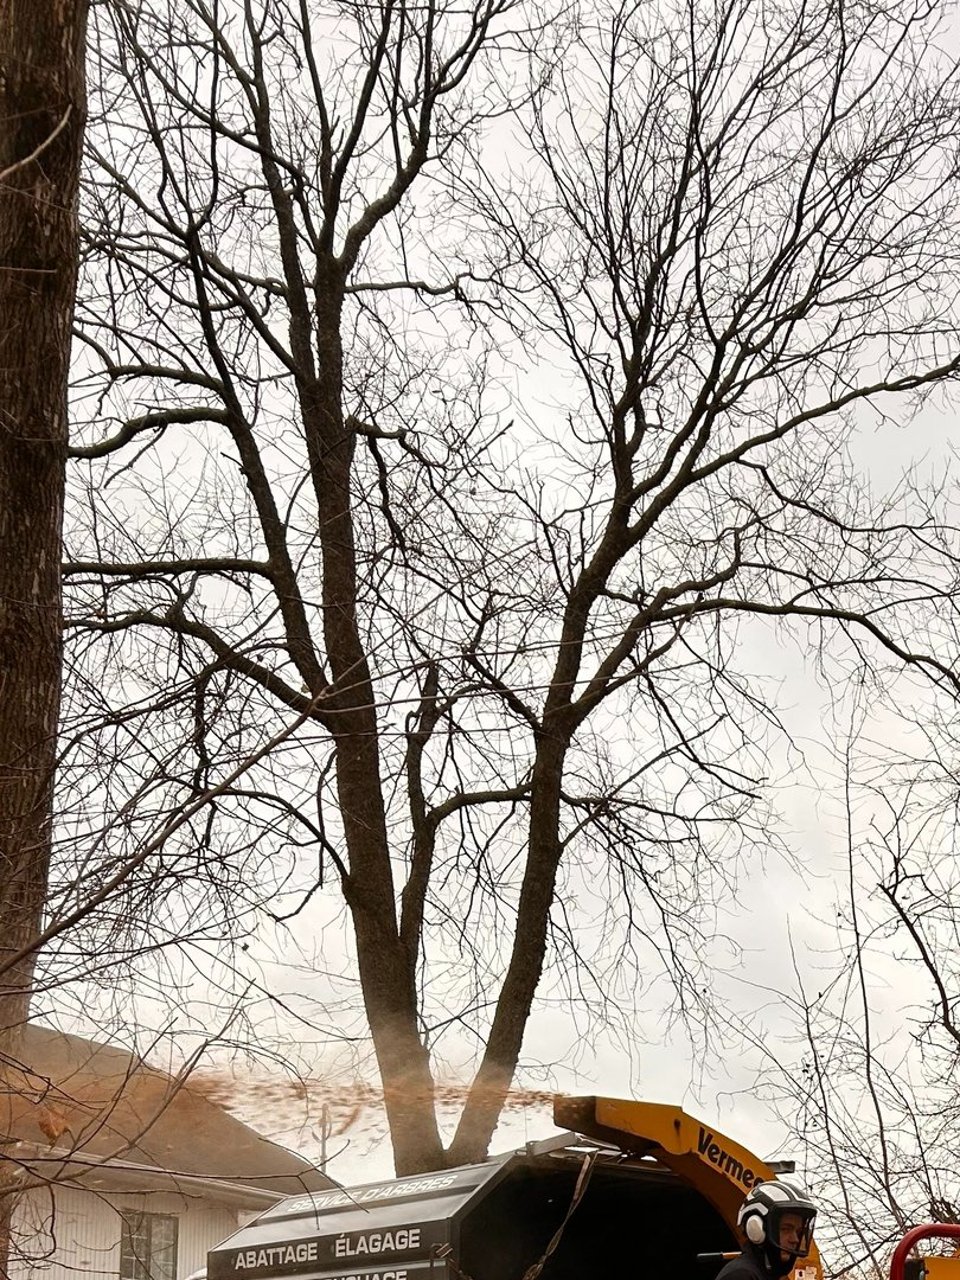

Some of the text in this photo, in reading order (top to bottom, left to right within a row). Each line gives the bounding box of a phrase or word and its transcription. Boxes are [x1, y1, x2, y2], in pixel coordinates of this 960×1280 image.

[288, 1175, 458, 1212] SERVICE D'ARBRES
[235, 1228, 421, 1270] ABATTAGE ÉLAGAGE
